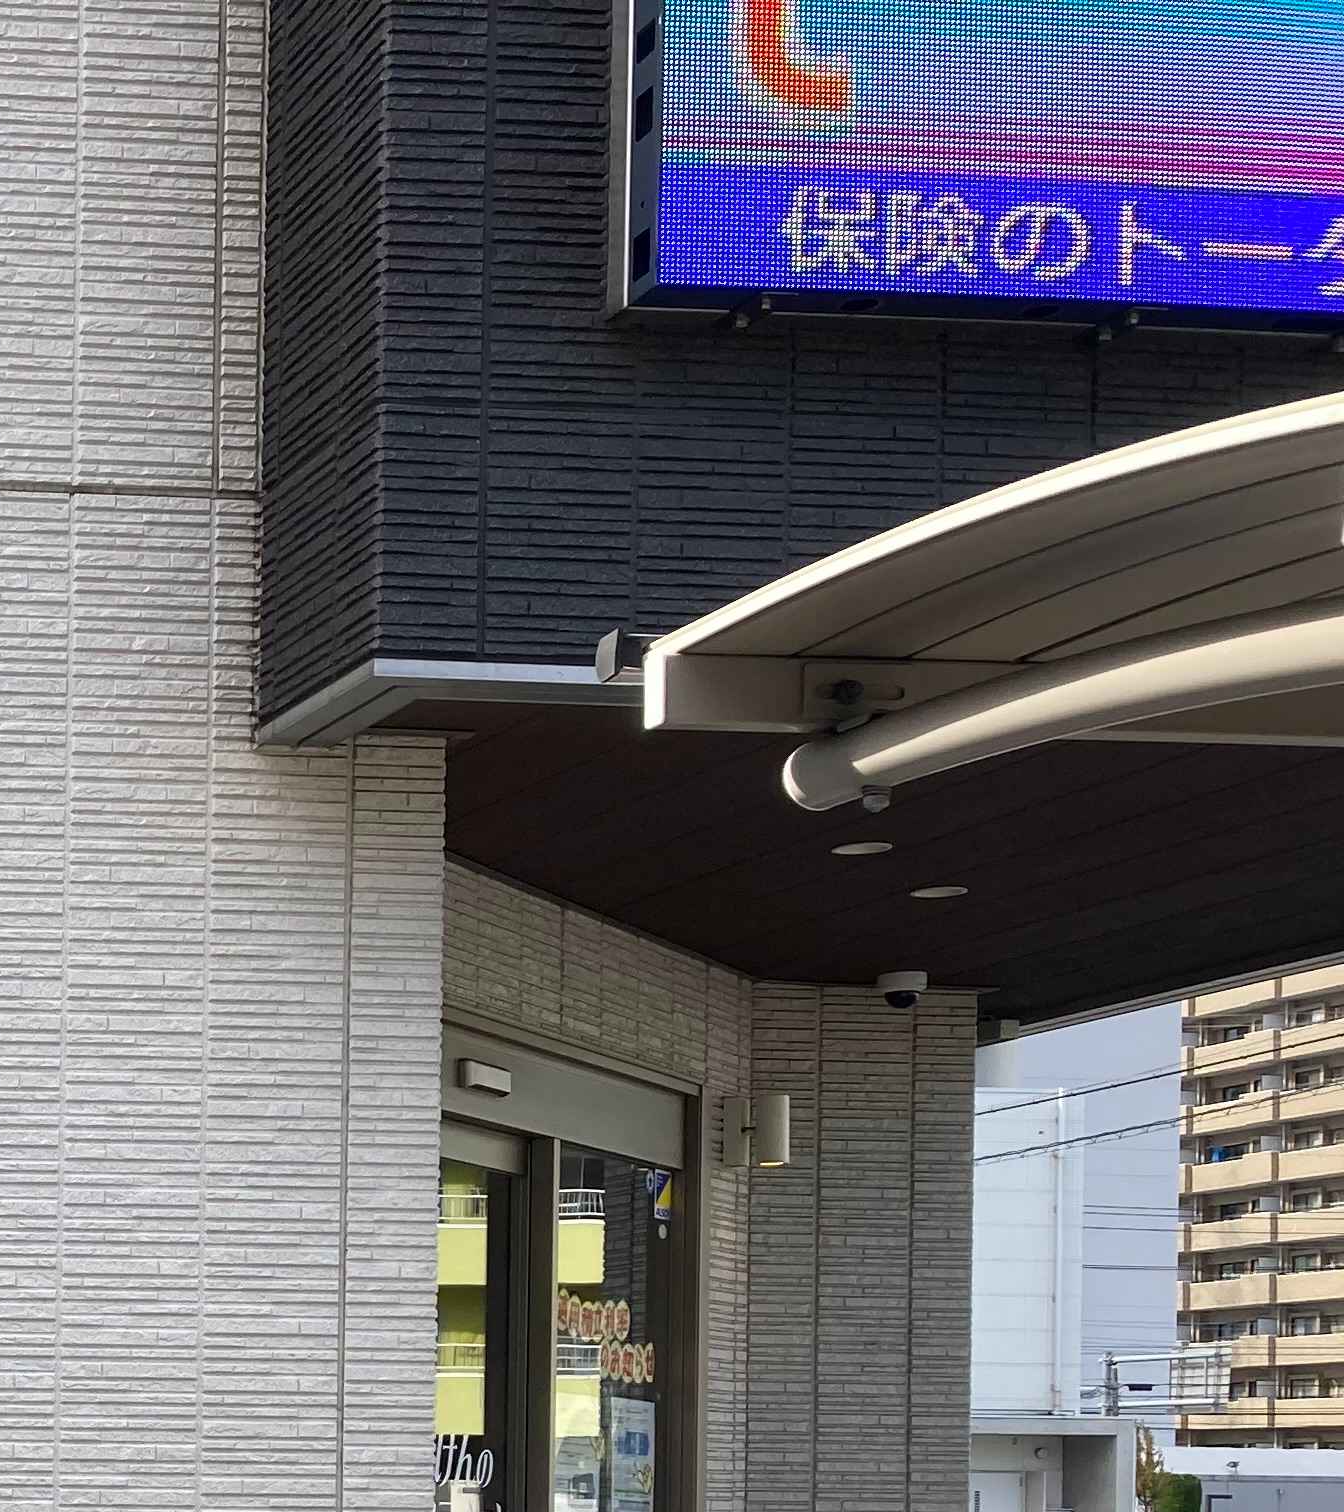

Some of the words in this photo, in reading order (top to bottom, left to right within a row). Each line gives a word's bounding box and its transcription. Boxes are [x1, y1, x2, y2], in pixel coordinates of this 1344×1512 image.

[601, 1342, 654, 1379] のお知らせ
